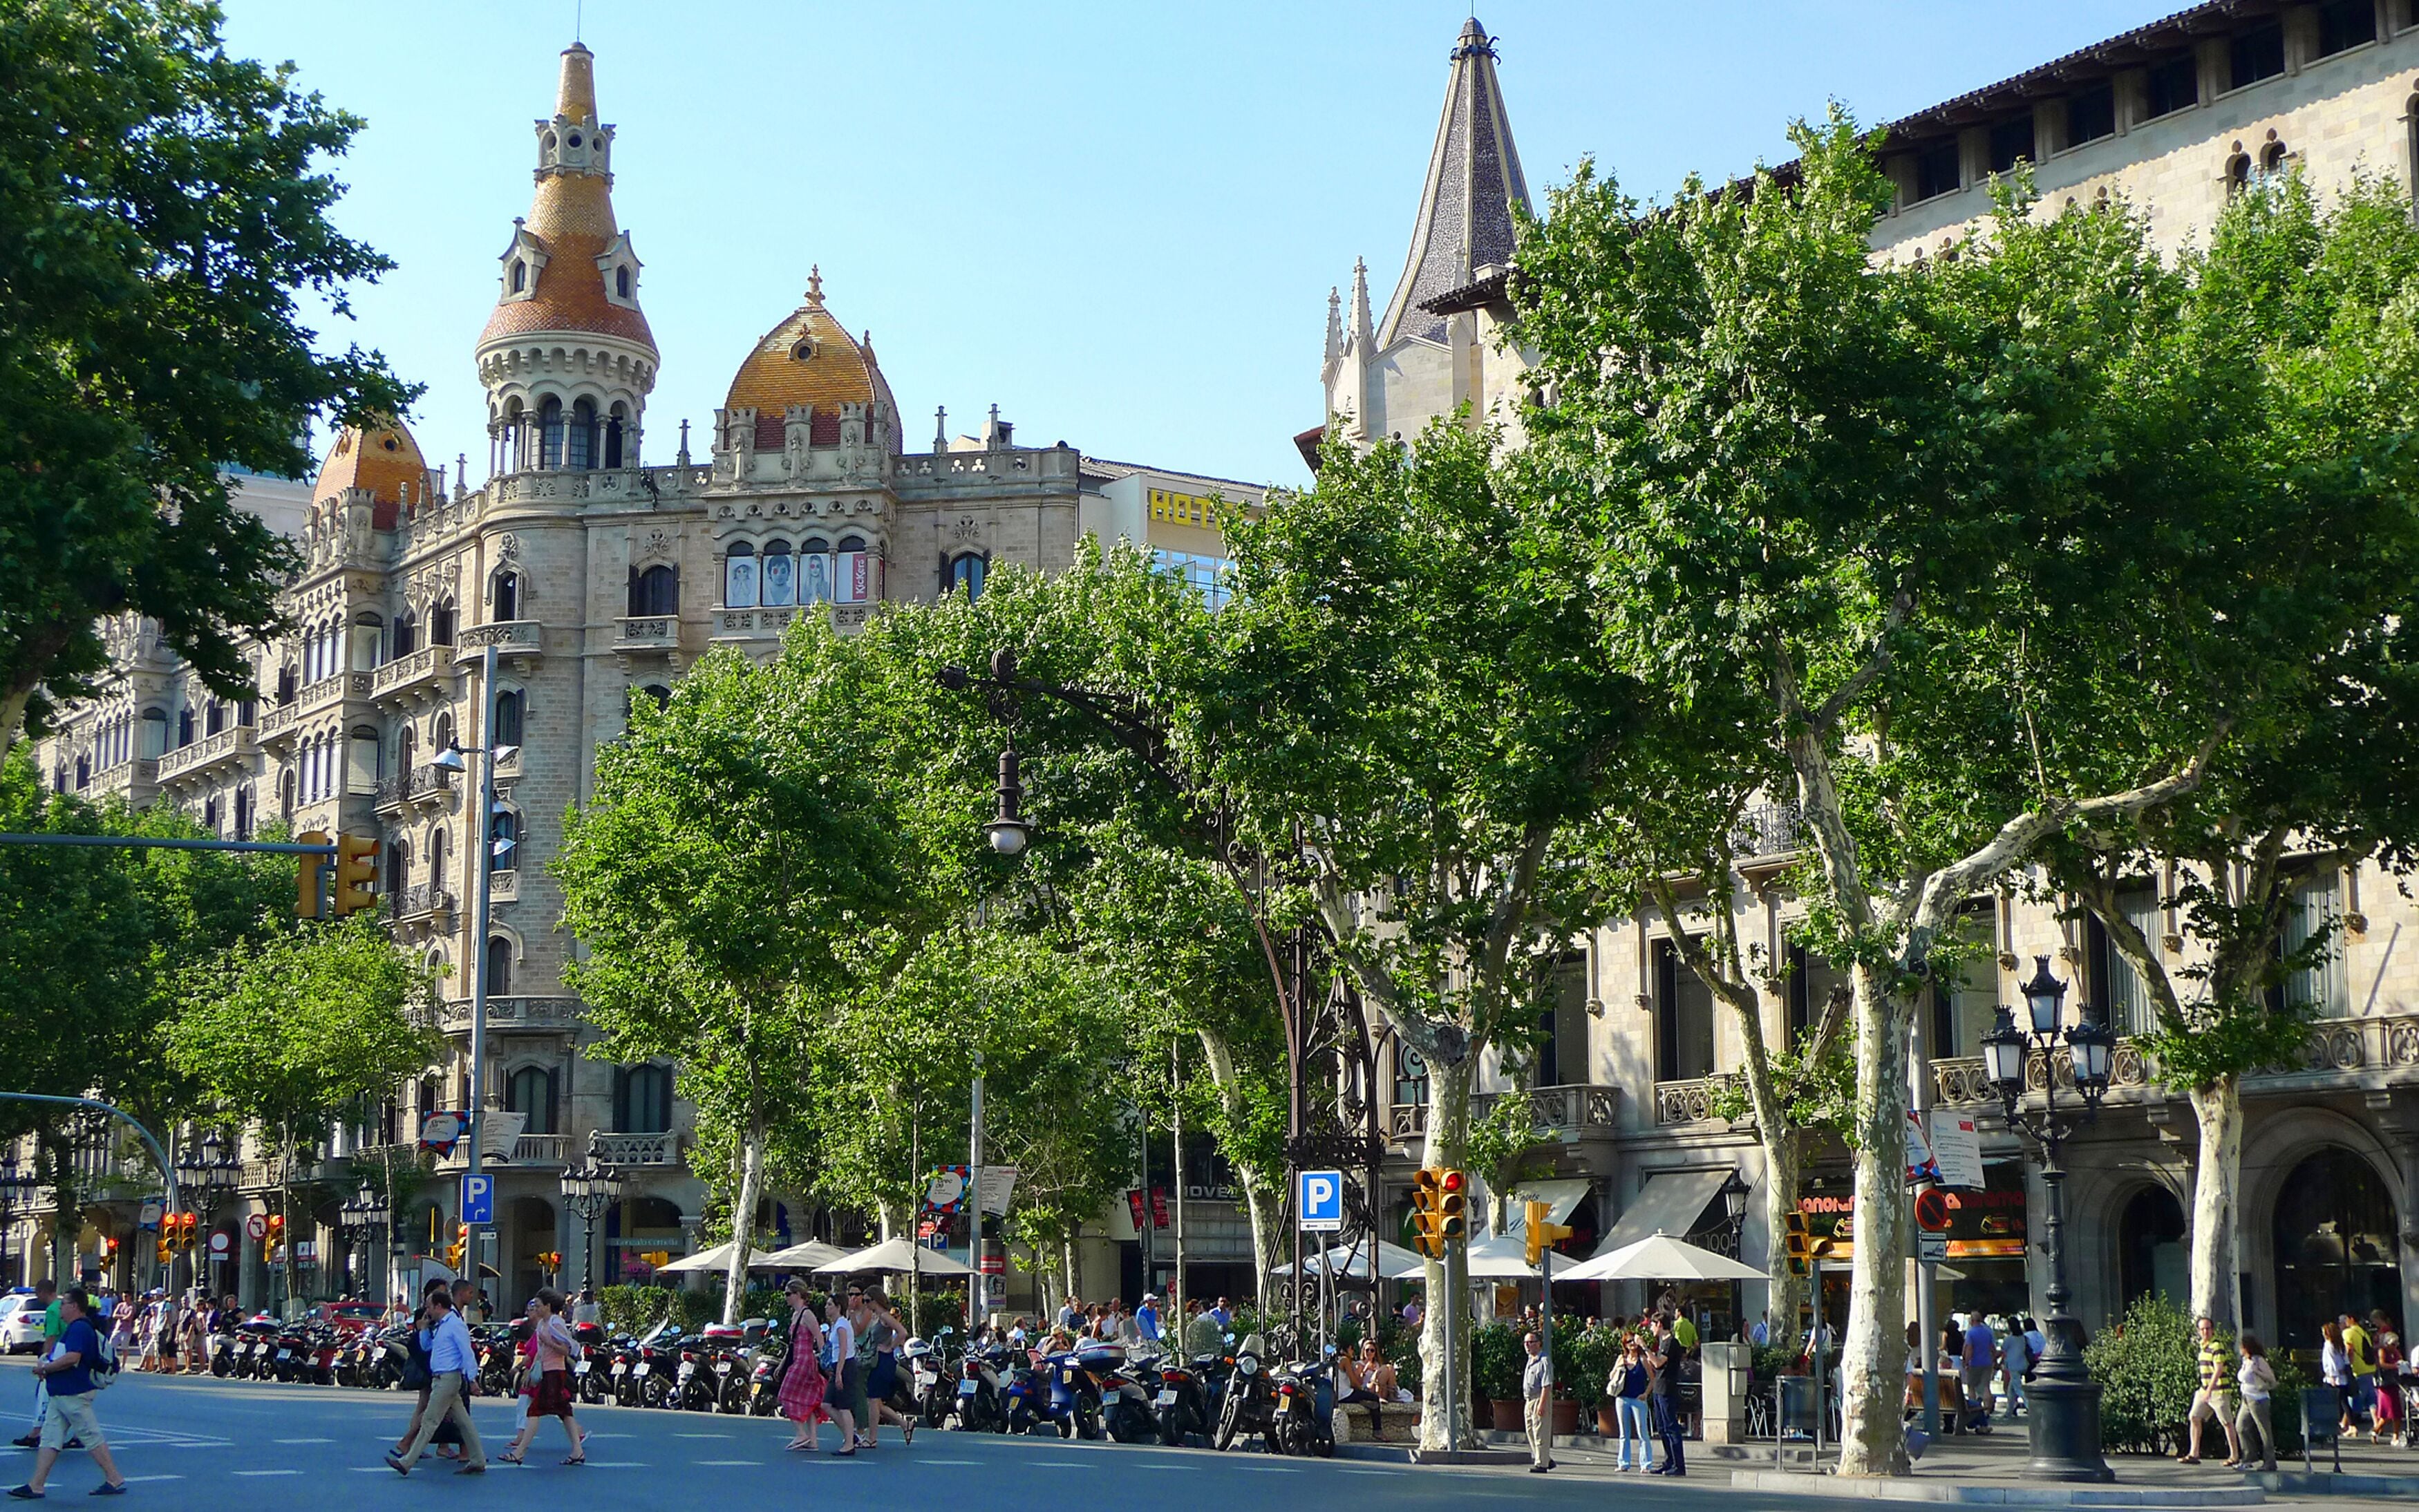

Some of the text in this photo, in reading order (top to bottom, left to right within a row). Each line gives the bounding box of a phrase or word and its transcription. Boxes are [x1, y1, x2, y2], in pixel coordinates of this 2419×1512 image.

[468, 1178, 487, 1203] P
[1308, 1178, 1333, 1215] P
[933, 1232, 944, 1247] P
